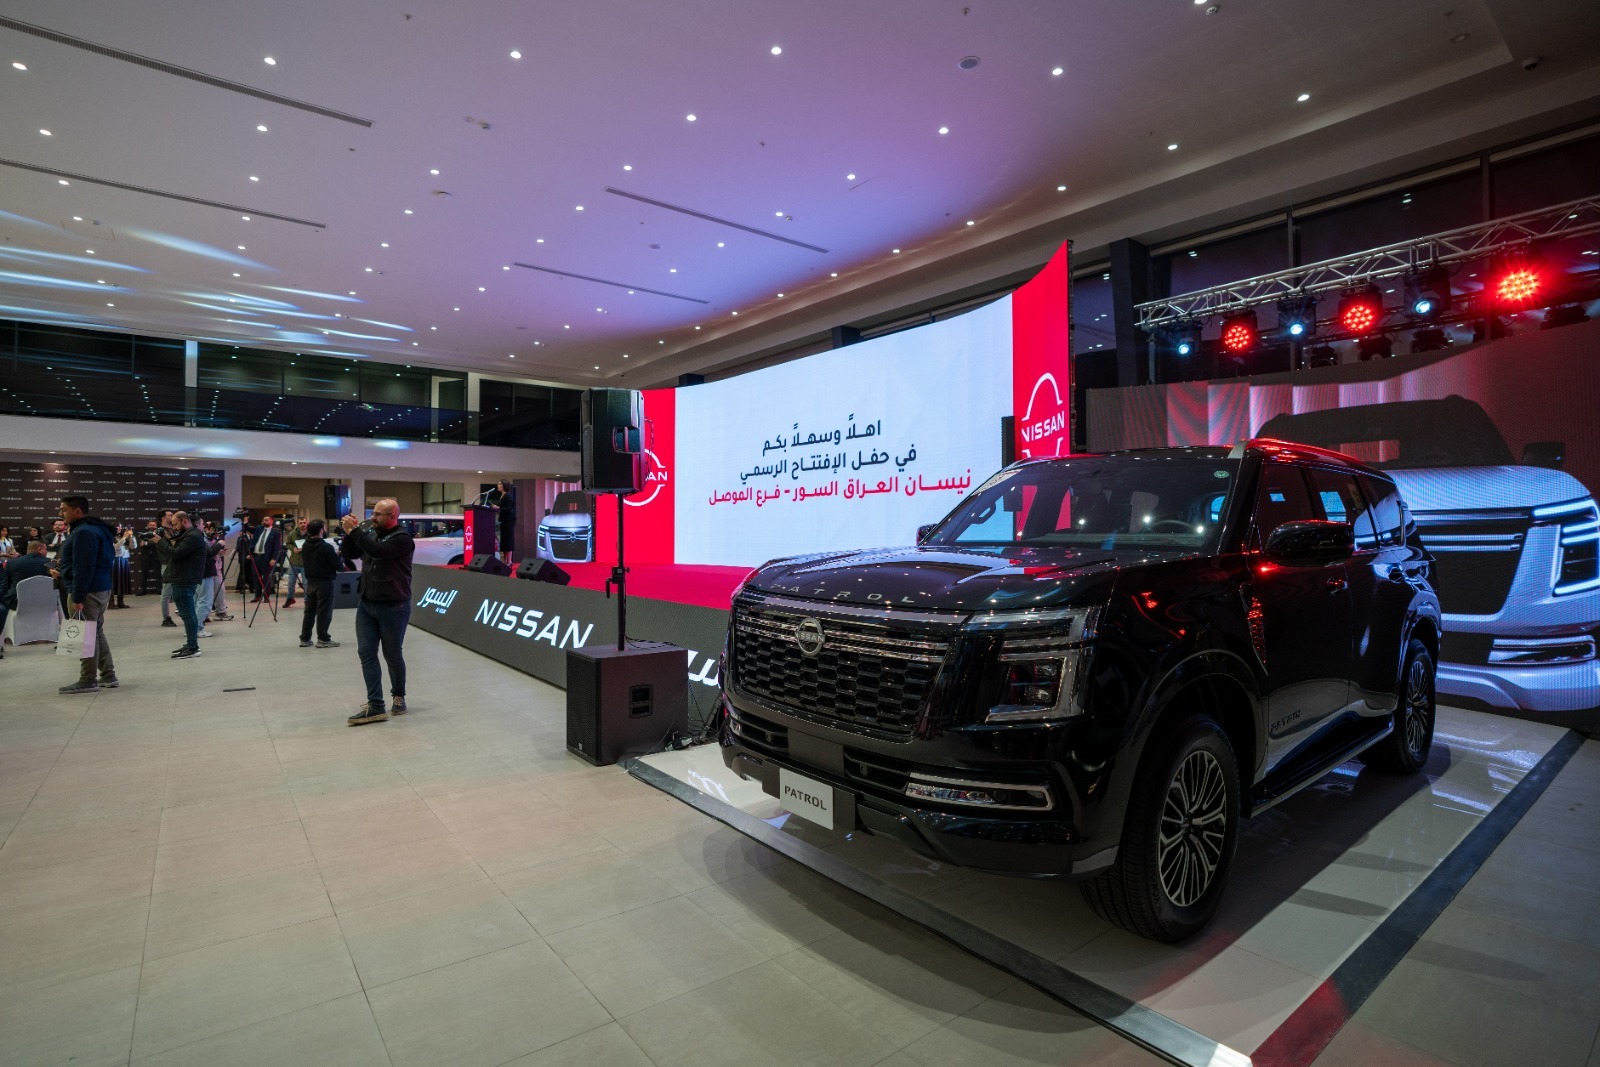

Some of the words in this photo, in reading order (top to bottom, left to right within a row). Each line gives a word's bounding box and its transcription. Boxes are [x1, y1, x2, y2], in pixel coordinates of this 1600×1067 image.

[1021, 411, 1065, 442] NISSAN
[763, 435, 787, 456] بكم
[791, 452, 846, 479] الإفتتاح
[851, 449, 889, 471] حفل
[895, 444, 917, 472] في
[740, 459, 787, 485] الرسمي
[904, 469, 971, 496] نيسان
[709, 486, 752, 506] الموصل
[756, 484, 780, 507] فرع
[792, 481, 838, 502] السور
[843, 476, 898, 499] العراق
[770, 583, 915, 603] PATROL
[474, 599, 594, 648] NISSAN
[784, 785, 827, 811] PATROL
